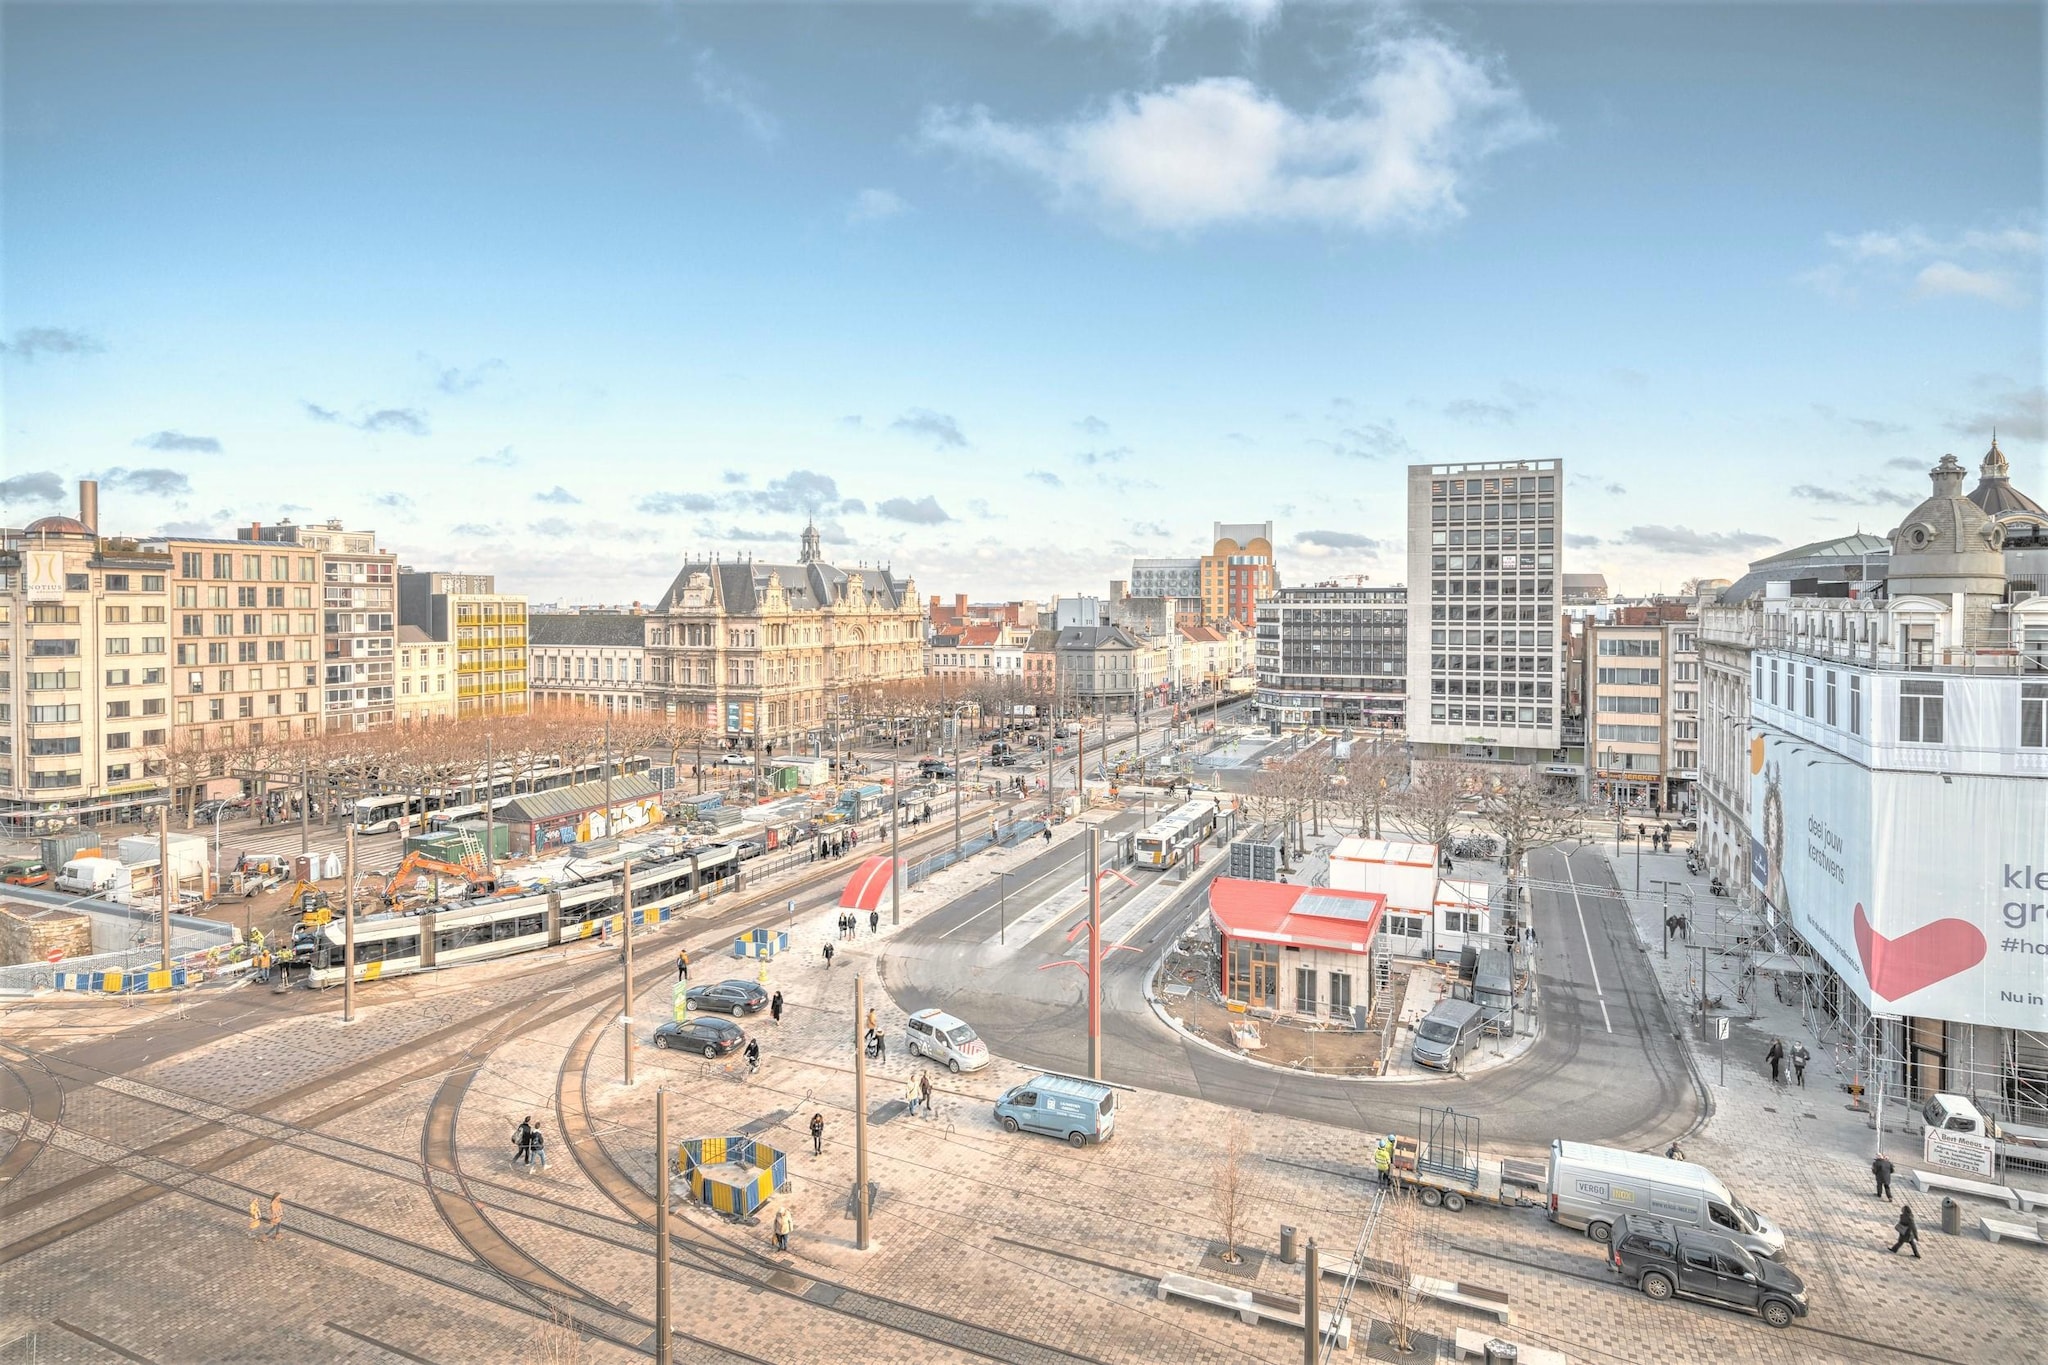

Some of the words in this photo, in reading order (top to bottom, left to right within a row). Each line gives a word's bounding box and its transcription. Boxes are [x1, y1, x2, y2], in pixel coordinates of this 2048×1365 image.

[1808, 814, 1823, 838] deel
[1824, 821, 1843, 855] jouw
[1808, 838, 1845, 885] kerstwens
[2004, 863, 2048, 891] kle
[2003, 901, 2048, 929] gr
[2001, 937, 2048, 955] #ha
[2001, 990, 2023, 1003] Nu
[2028, 993, 2043, 1005] in
[1942, 1134, 1957, 1142] Bert
[1959, 1138, 1982, 1148] Meeus
[1579, 1182, 1605, 1195] VERGO
[1613, 1188, 1632, 1201] INOX
